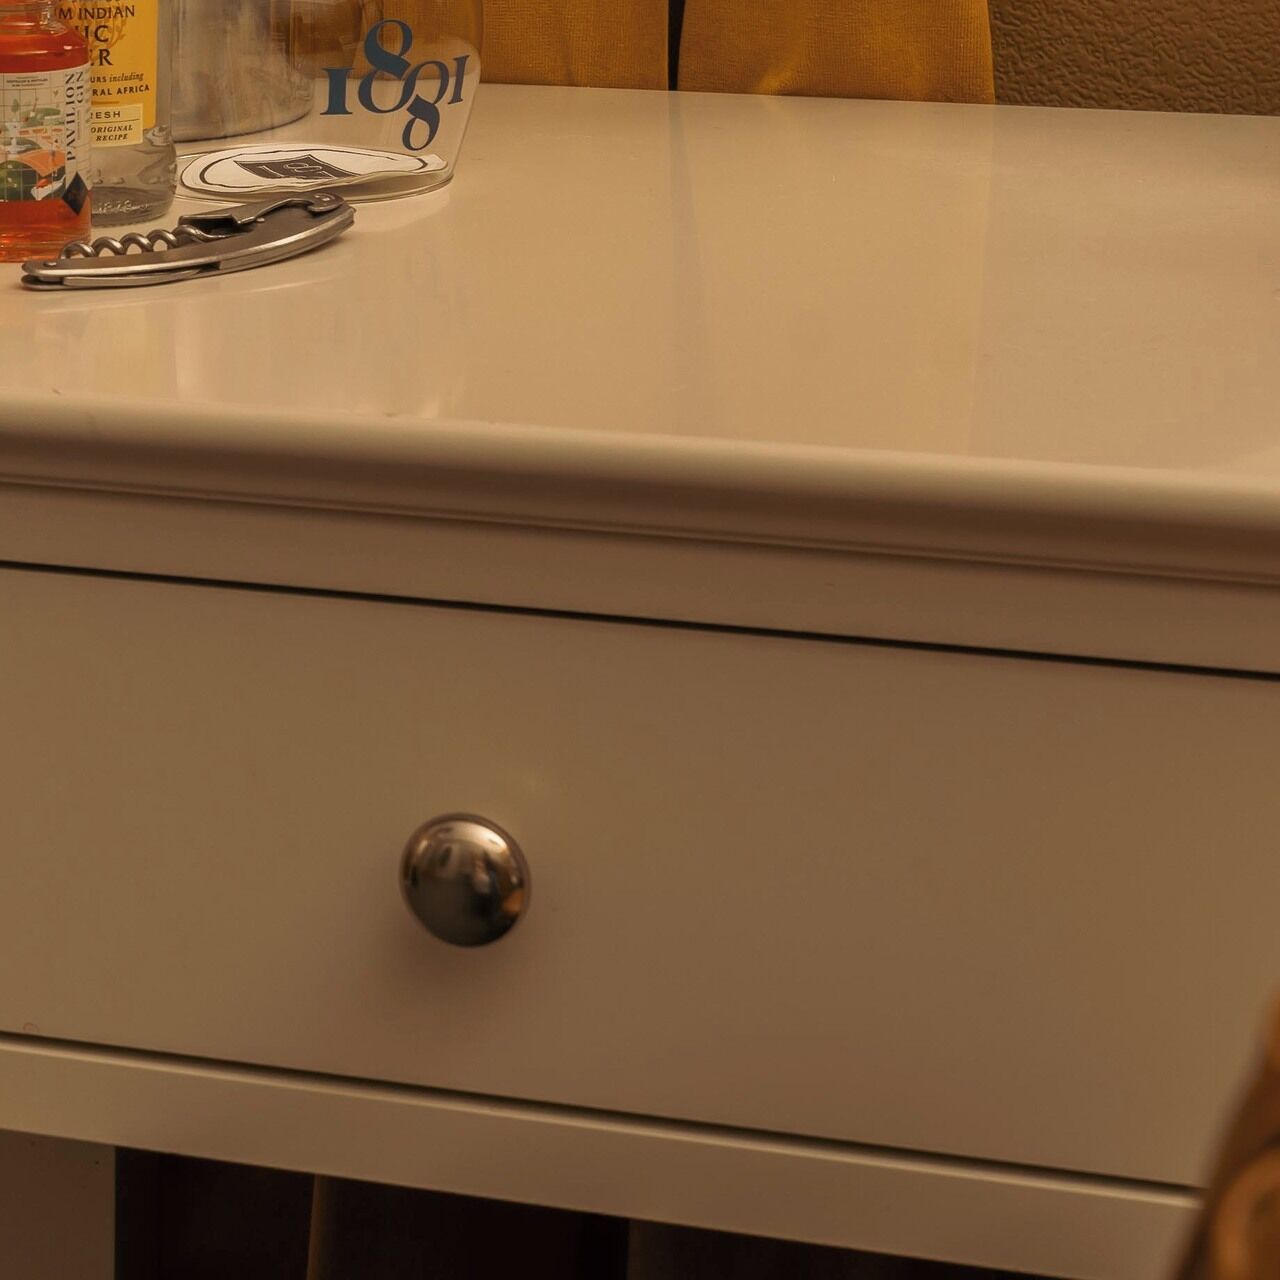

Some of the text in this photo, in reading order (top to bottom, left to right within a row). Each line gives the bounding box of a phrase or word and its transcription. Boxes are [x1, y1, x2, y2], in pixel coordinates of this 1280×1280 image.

[79, 5, 135, 20] INDIAN
[74, 24, 109, 43] IC
[109, 71, 144, 82] including
[116, 83, 150, 96] AFRICA
[65, 73, 76, 161] PAVILION
[90, 124, 133, 134] ORIGINAL
[96, 133, 128, 142] RECIPE
